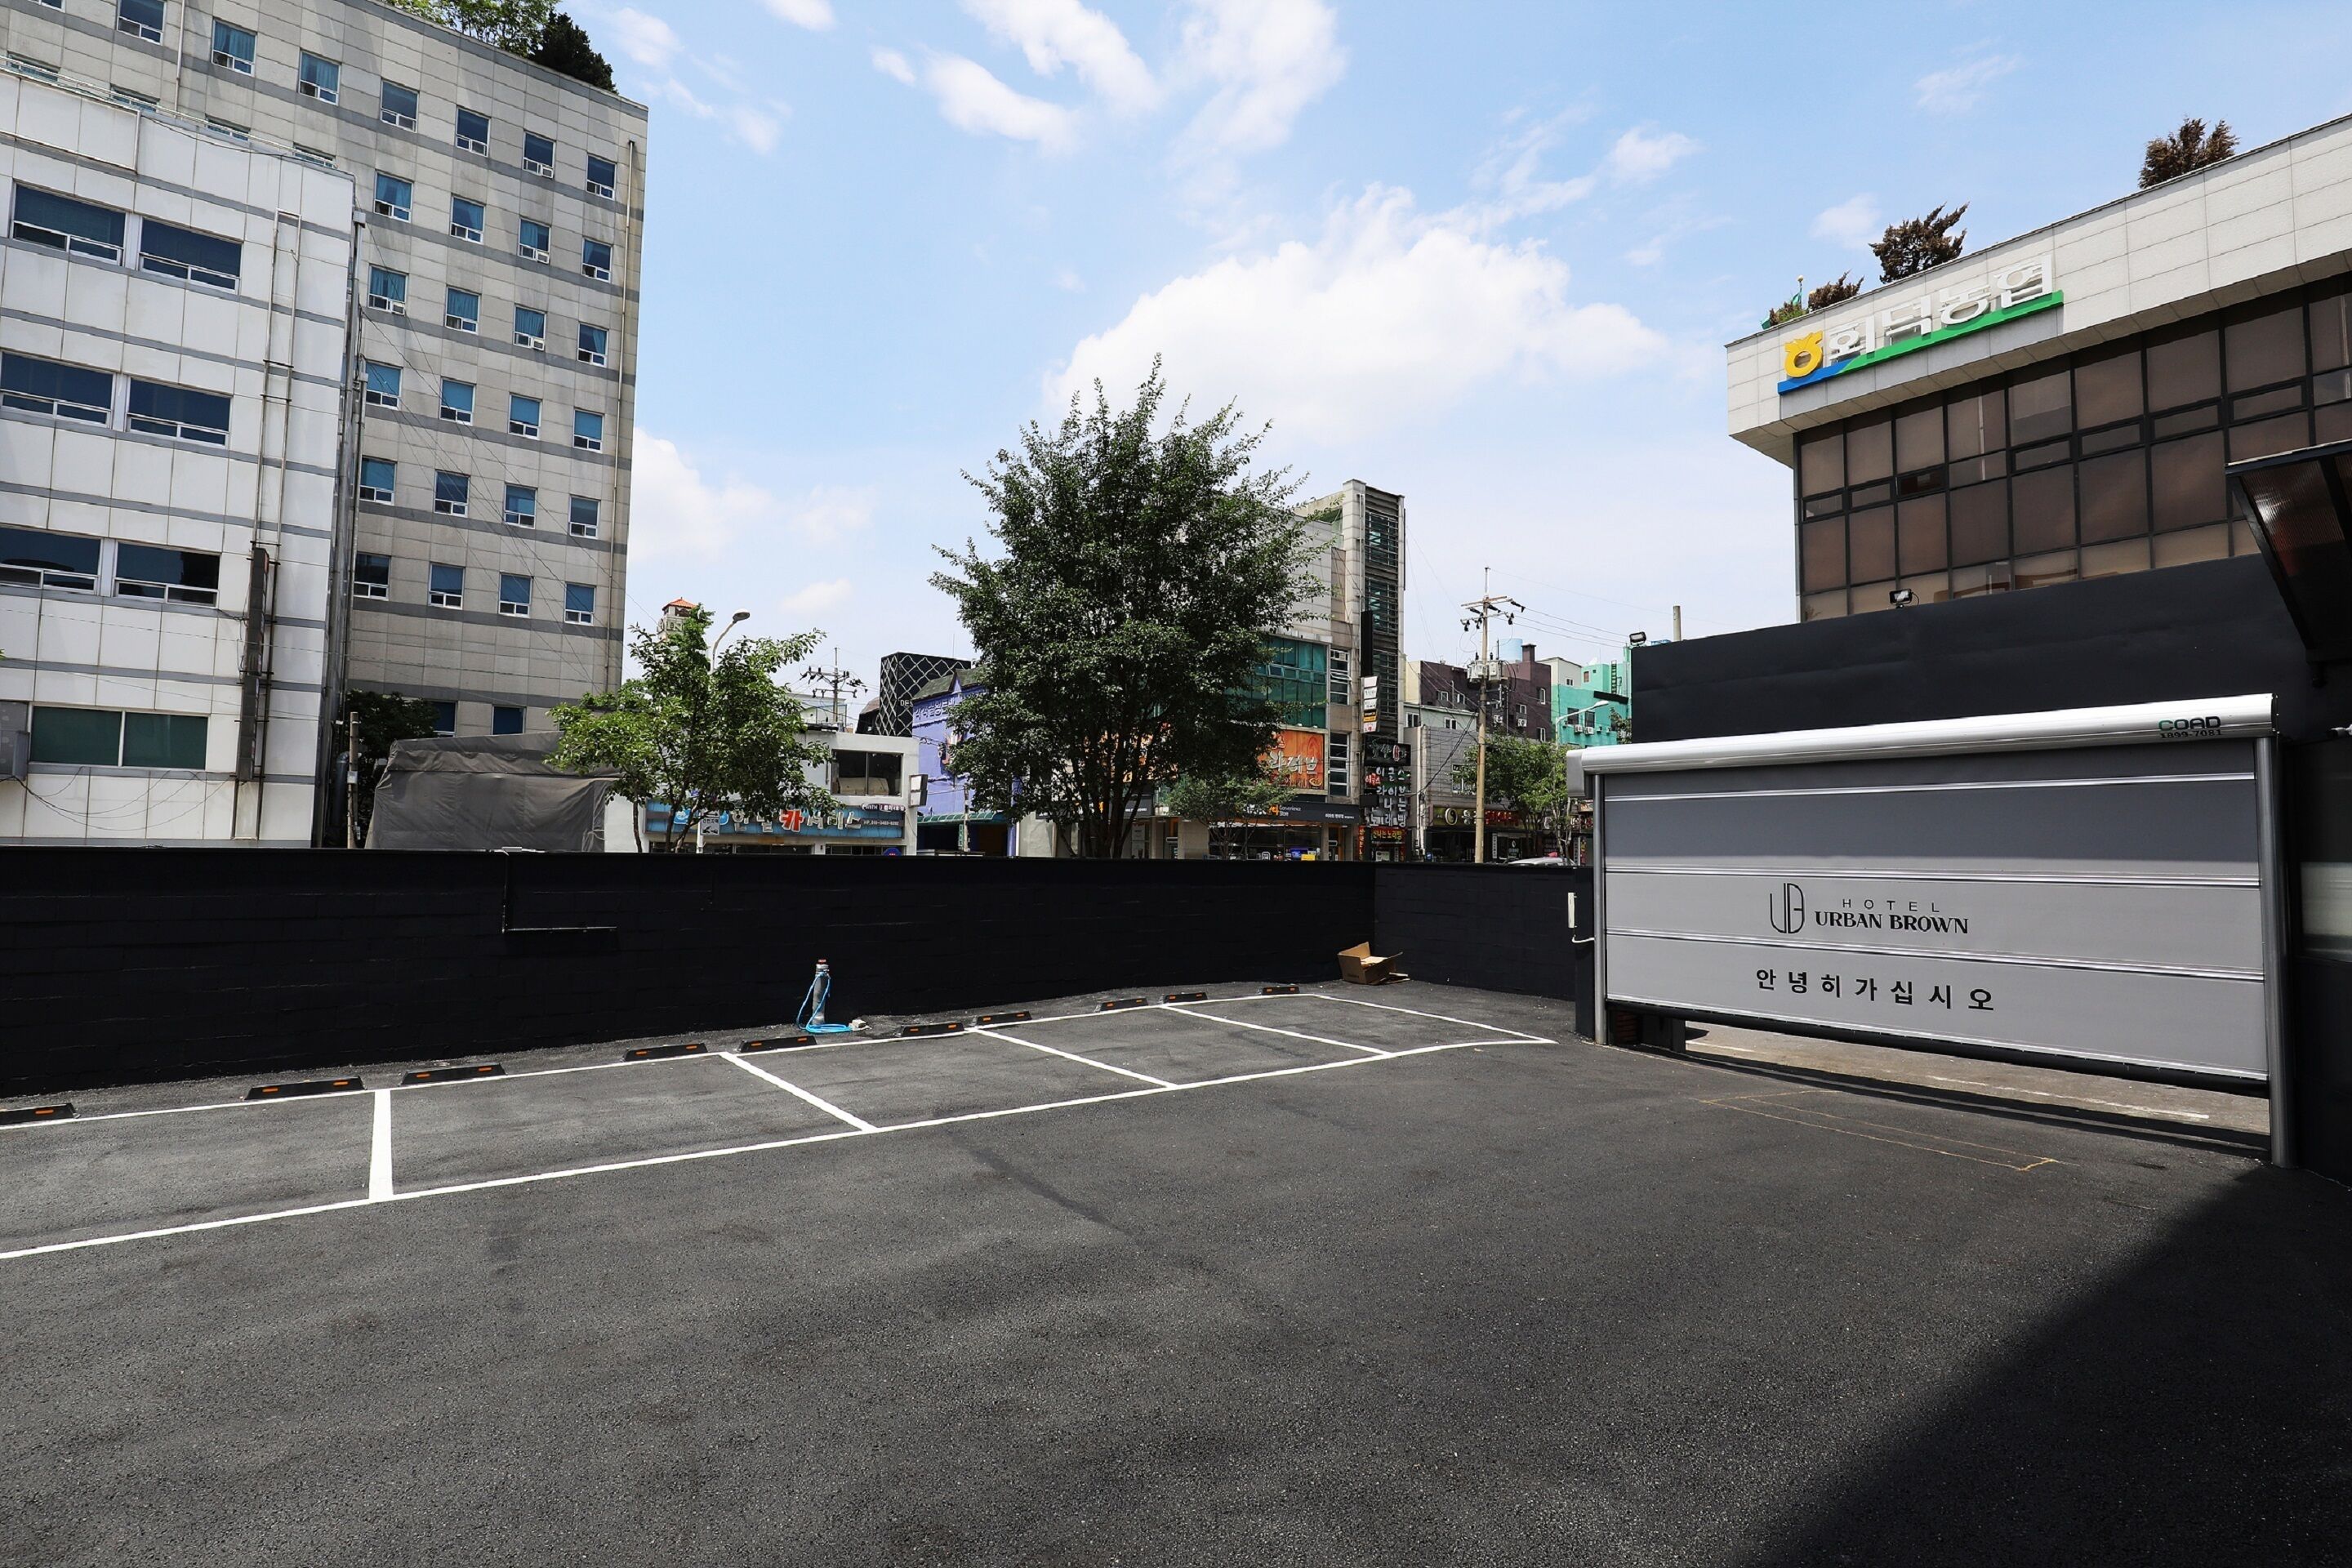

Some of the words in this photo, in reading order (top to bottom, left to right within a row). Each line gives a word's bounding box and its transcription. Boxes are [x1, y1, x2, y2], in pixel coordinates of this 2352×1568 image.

[1828, 254, 2054, 360] 회덕농협
[2158, 715, 2221, 732] COAD
[2158, 729, 2222, 739] 1899-7081
[1375, 766, 1405, 782] 이글스
[1376, 785, 1405, 797] 라이브
[1843, 898, 1940, 913] HOTEL
[1815, 911, 1883, 929] URBAN
[1889, 915, 1969, 934] BROWN
